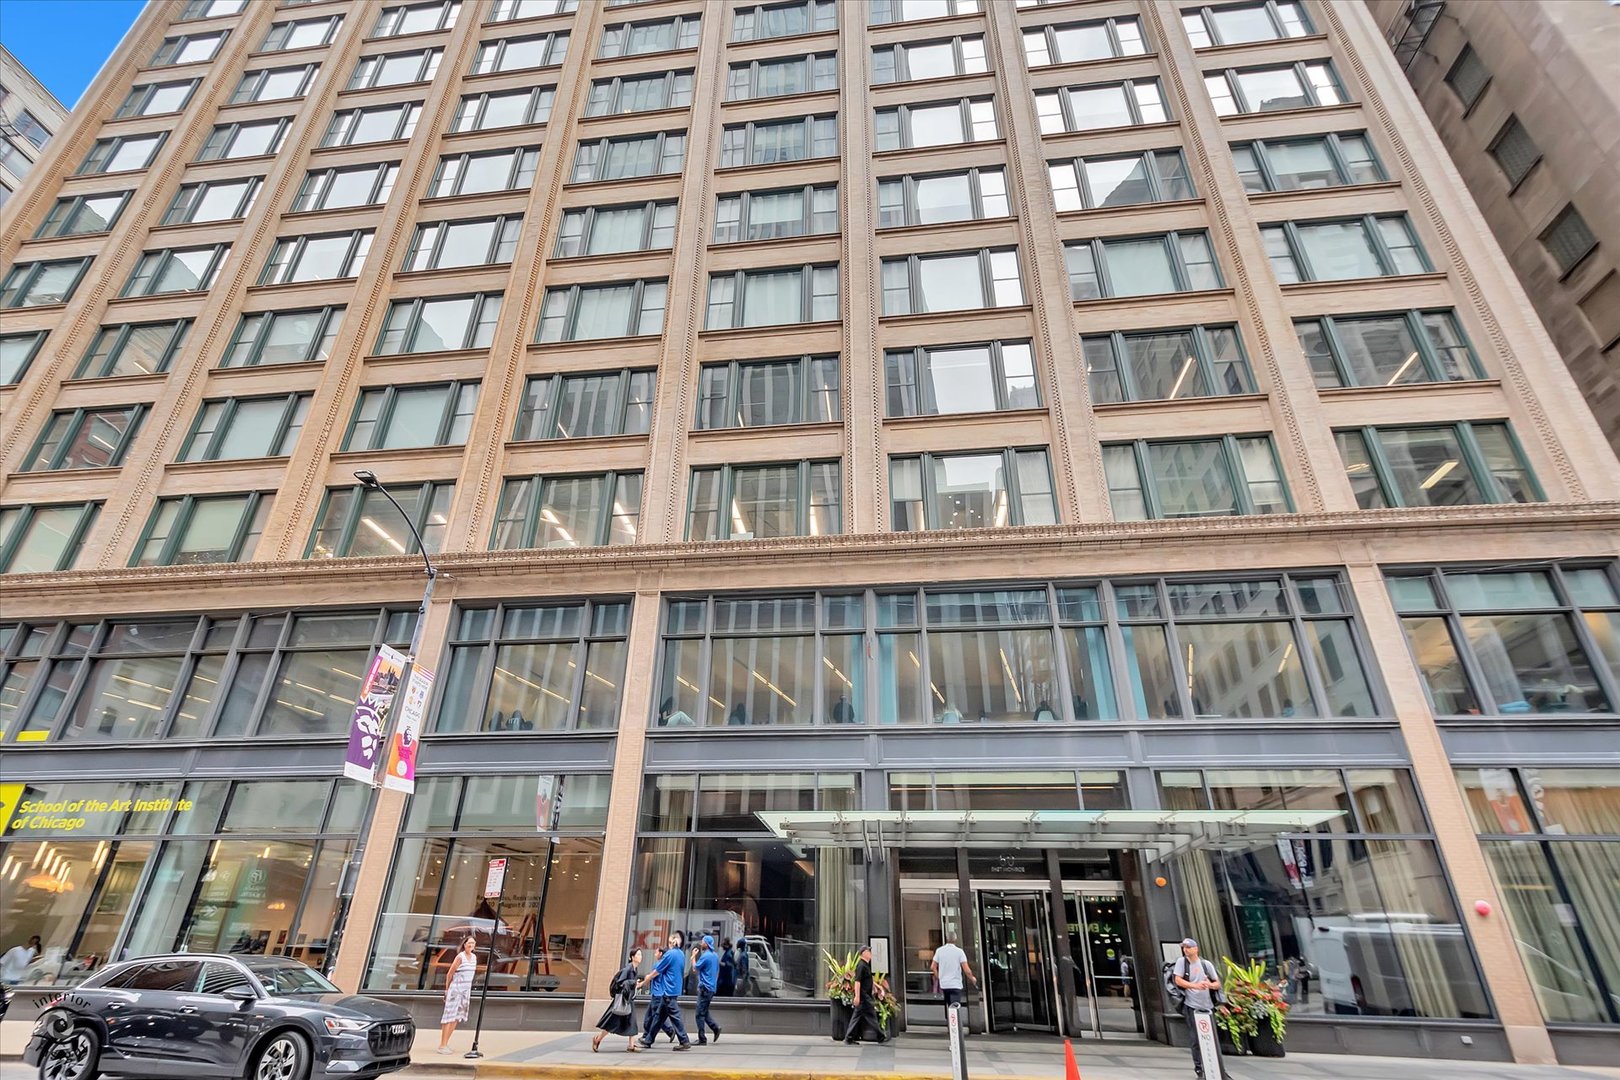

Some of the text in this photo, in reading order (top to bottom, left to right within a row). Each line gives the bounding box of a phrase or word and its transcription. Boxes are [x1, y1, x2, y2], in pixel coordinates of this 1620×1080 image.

[19, 799, 66, 814] School
[67, 799, 85, 813] of
[85, 799, 107, 813] the
[107, 799, 132, 812] Art
[11, 815, 86, 831] of Chicago
